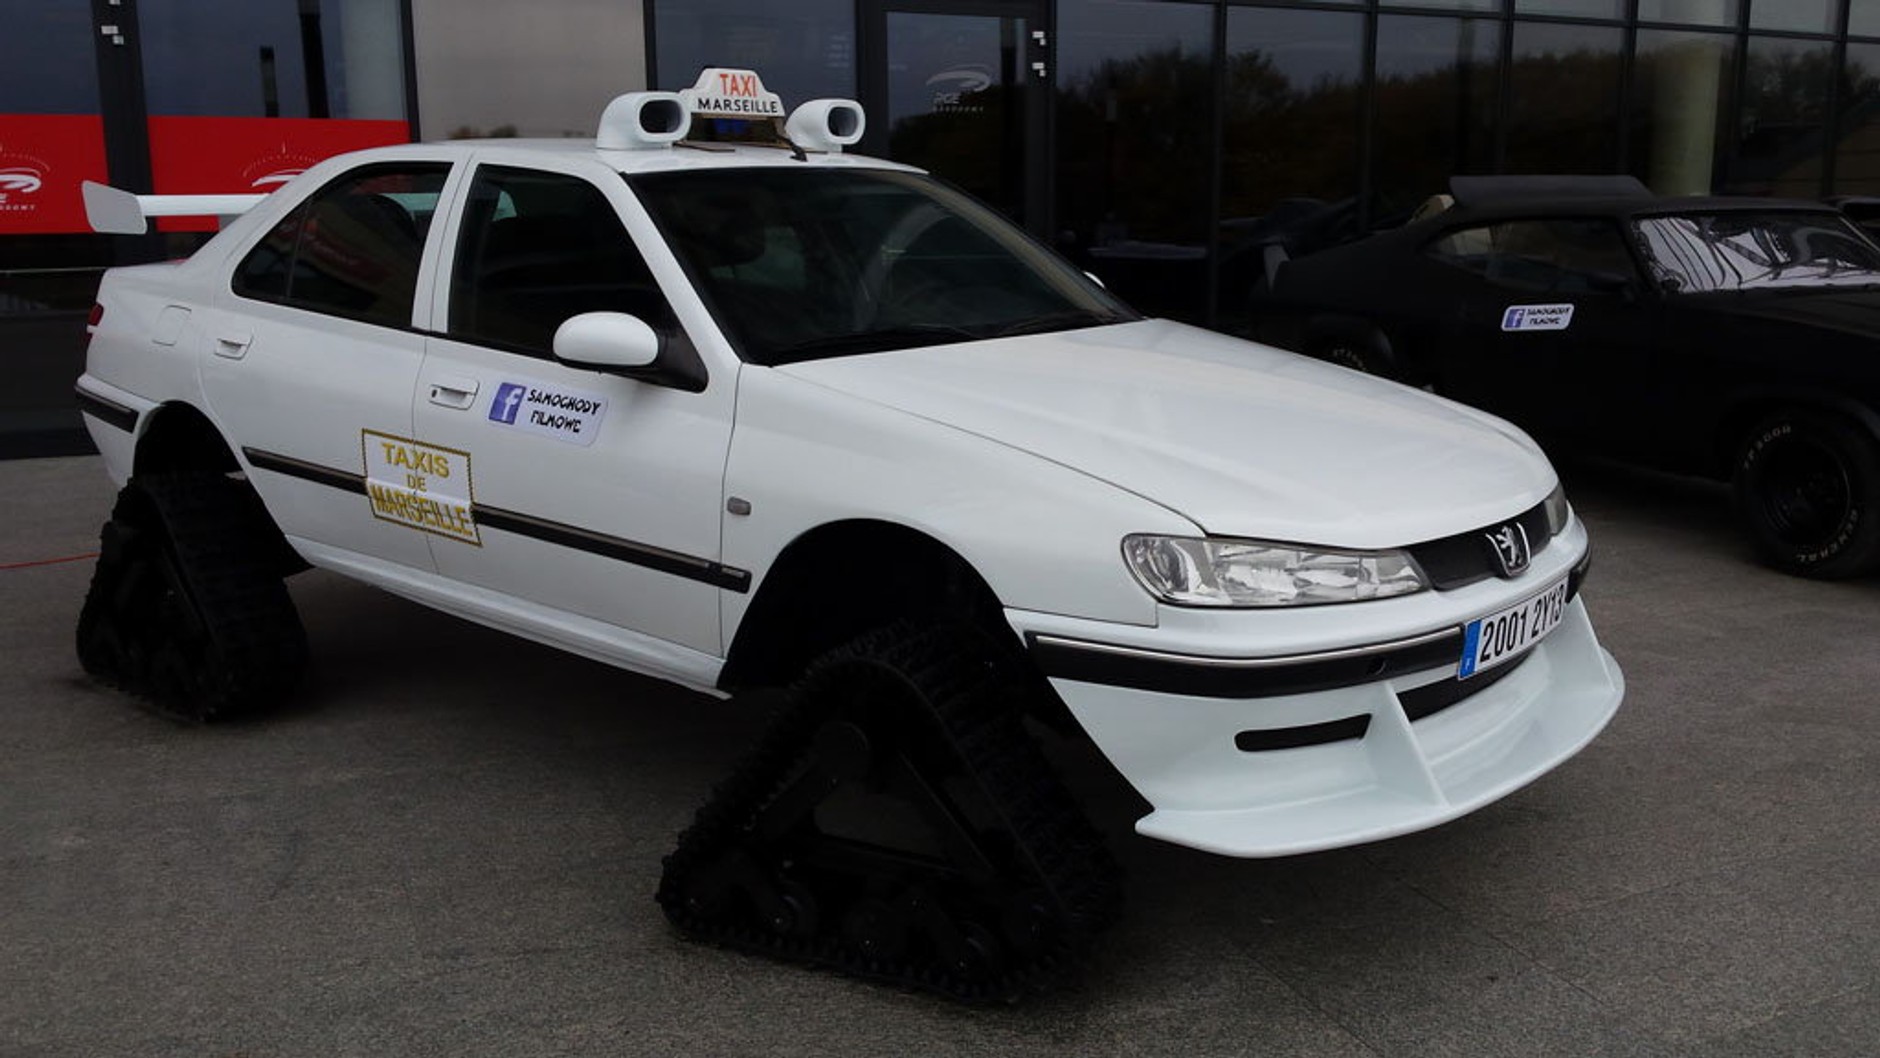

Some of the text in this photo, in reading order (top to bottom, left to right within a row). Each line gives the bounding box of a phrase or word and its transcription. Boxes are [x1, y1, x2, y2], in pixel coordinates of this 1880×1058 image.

[719, 73, 757, 98] TAXI
[697, 97, 778, 113] MARSEILLE
[527, 388, 601, 416] SAMOCHODY
[530, 410, 582, 434] FILMOWE
[382, 442, 450, 479] TAXIS
[405, 474, 427, 493] DE
[370, 484, 473, 537] MARSEILLE
[1480, 584, 1565, 662] 2001 2Y13
